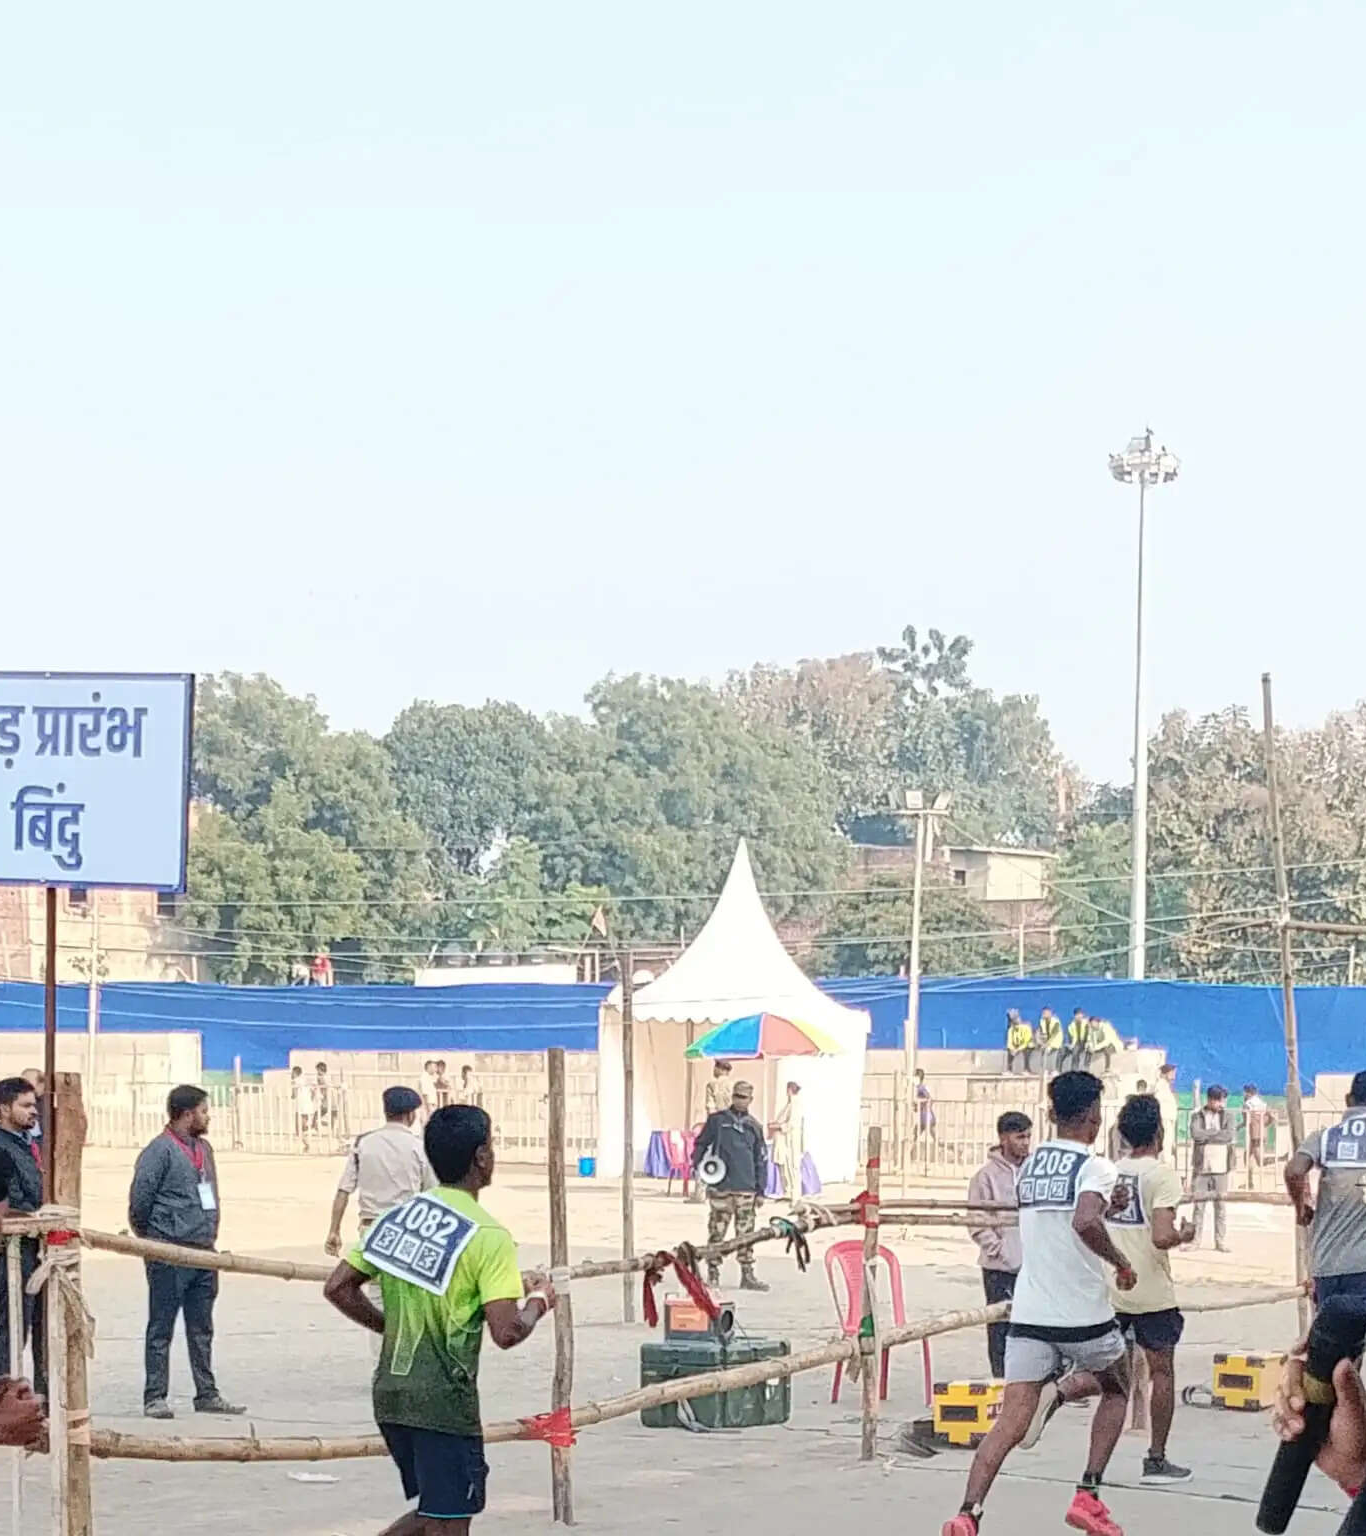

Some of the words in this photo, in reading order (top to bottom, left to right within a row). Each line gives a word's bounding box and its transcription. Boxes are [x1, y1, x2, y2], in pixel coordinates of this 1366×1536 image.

[32, 692, 148, 758] प्रारंभ
[10, 782, 85, 871] बिंदु
[1026, 1150, 1077, 1177] 1208
[395, 1200, 459, 1246] 1082
